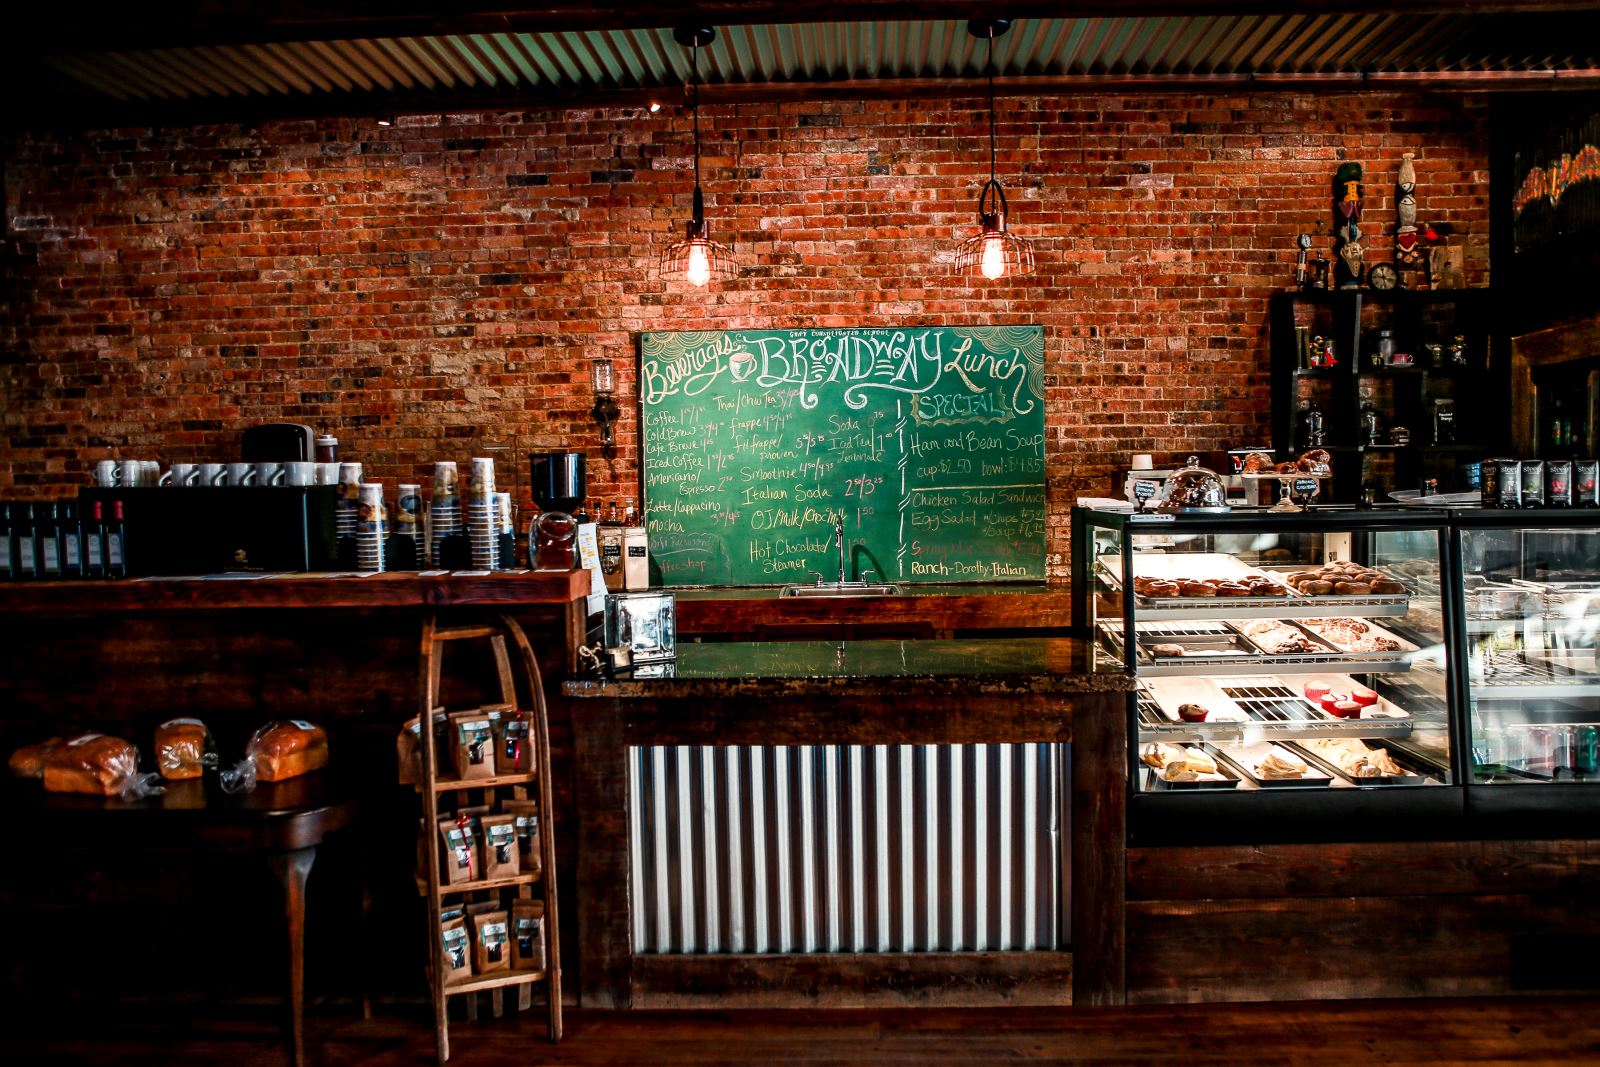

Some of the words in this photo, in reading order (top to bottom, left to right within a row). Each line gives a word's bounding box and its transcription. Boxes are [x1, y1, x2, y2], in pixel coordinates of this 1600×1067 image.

[642, 334, 742, 405] Beverages
[742, 331, 945, 409] BROADWAY
[944, 337, 1034, 414] Lunch
[918, 392, 1006, 420] SPECIAL
[646, 411, 679, 427] Coffee
[828, 414, 861, 435] Soda
[646, 428, 667, 442] Cold
[667, 426, 697, 441] Brew
[828, 437, 854, 451] Iced
[910, 432, 941, 458] Ham
[943, 431, 965, 450] and
[965, 430, 1002, 452] Bean
[1006, 428, 1043, 456] Soup
[646, 456, 672, 469] Iced
[672, 453, 704, 471] Coffee
[739, 463, 798, 482] Smoothie
[679, 482, 716, 496] Espresso
[741, 485, 788, 505] Italian
[794, 483, 831, 502] Soda
[912, 491, 957, 508] Chicken
[962, 490, 995, 505] Salad
[648, 519, 685, 533] Mocha
[911, 511, 940, 532] Egg
[941, 508, 976, 527] Salad
[750, 538, 772, 564] Hot
[763, 558, 807, 574] Steamer
